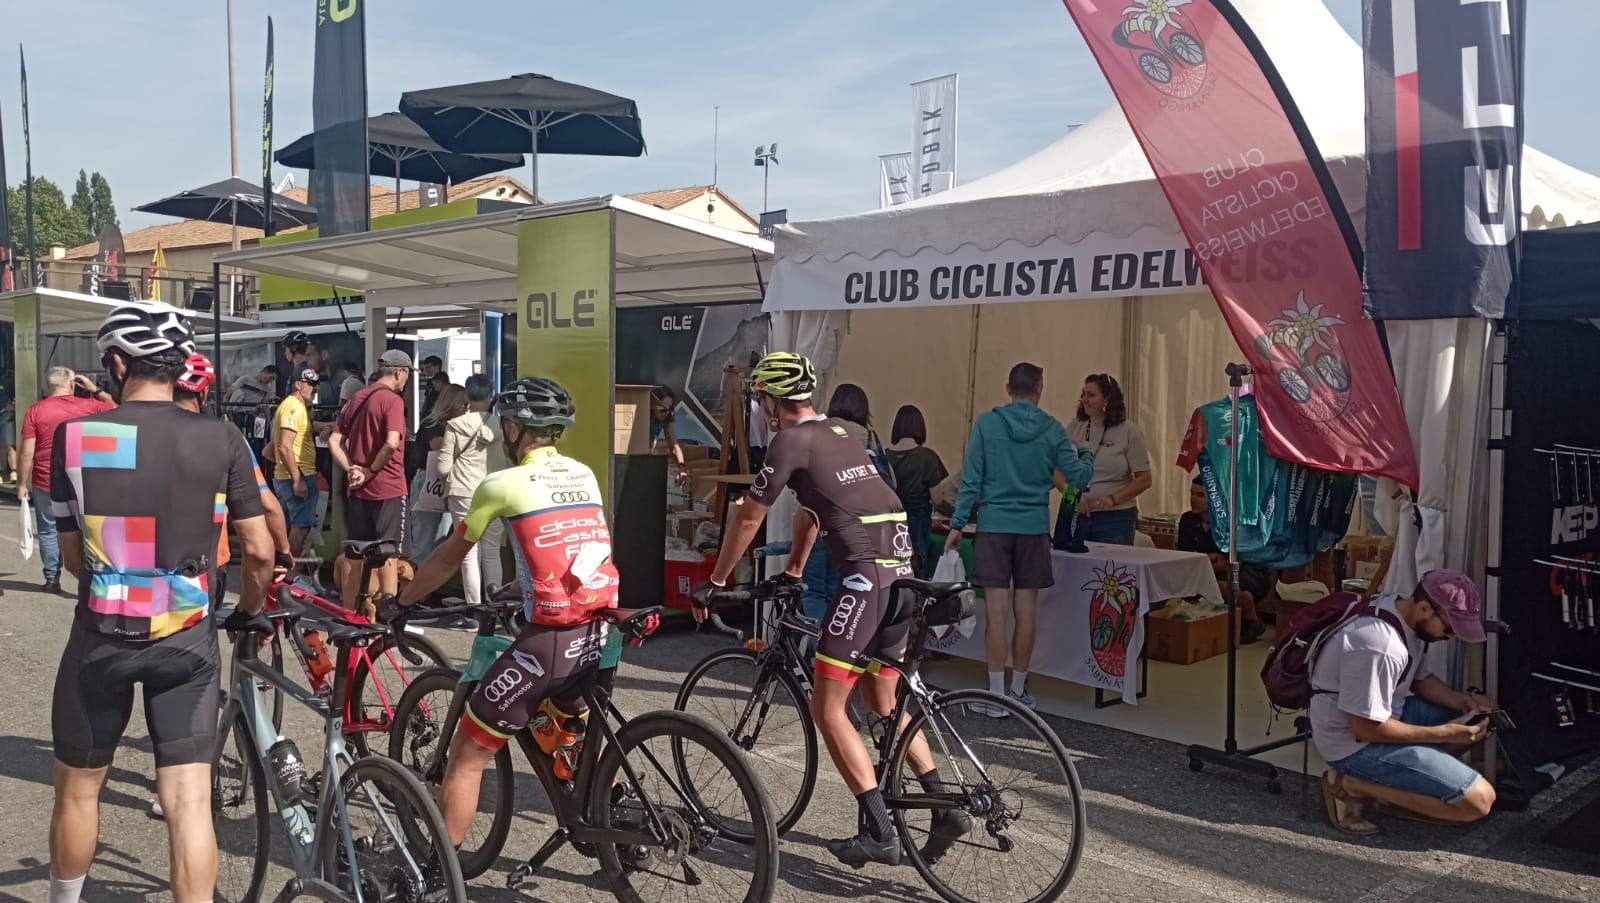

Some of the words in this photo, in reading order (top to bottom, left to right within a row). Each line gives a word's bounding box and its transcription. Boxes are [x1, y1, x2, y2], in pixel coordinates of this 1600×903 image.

[844, 268, 920, 304] CLUB
[929, 257, 1078, 300] CICLISTA
[836, 464, 868, 482] LASTSET
[845, 600, 868, 641] Safamotor
[498, 681, 534, 712] Safamotor
